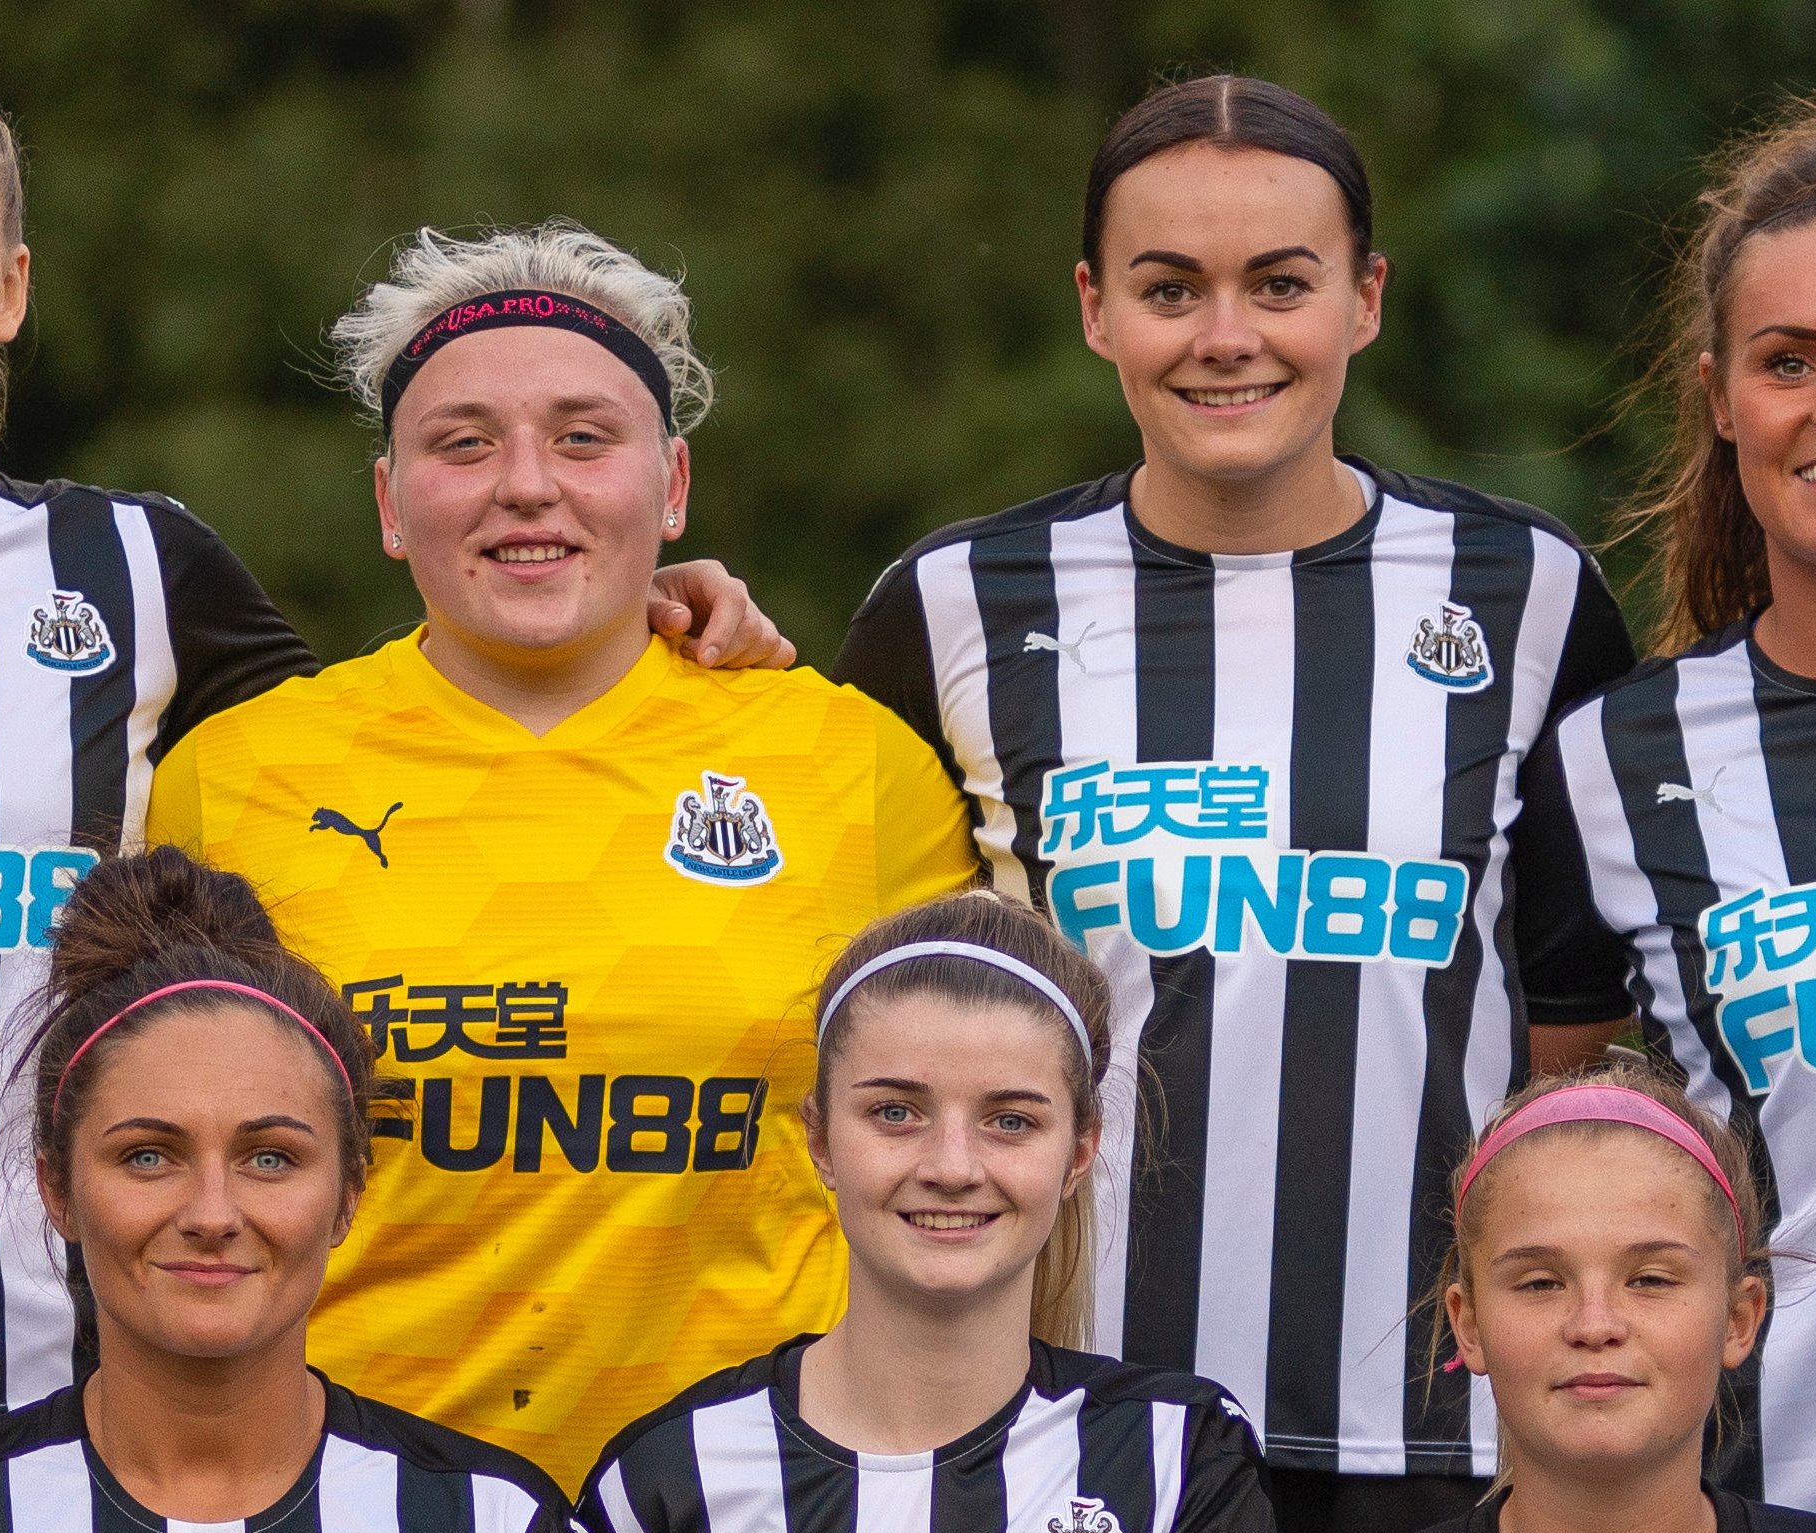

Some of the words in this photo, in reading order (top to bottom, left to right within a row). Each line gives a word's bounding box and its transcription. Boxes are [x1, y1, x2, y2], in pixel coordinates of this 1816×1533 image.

[447, 303, 494, 331] USA
[503, 295, 554, 317] PRO
[1043, 760, 1270, 853] 乐天堂
[687, 861, 739, 877] NEWCASTLE
[739, 865, 767, 878] UNITED
[1051, 855, 1467, 962] FUN88
